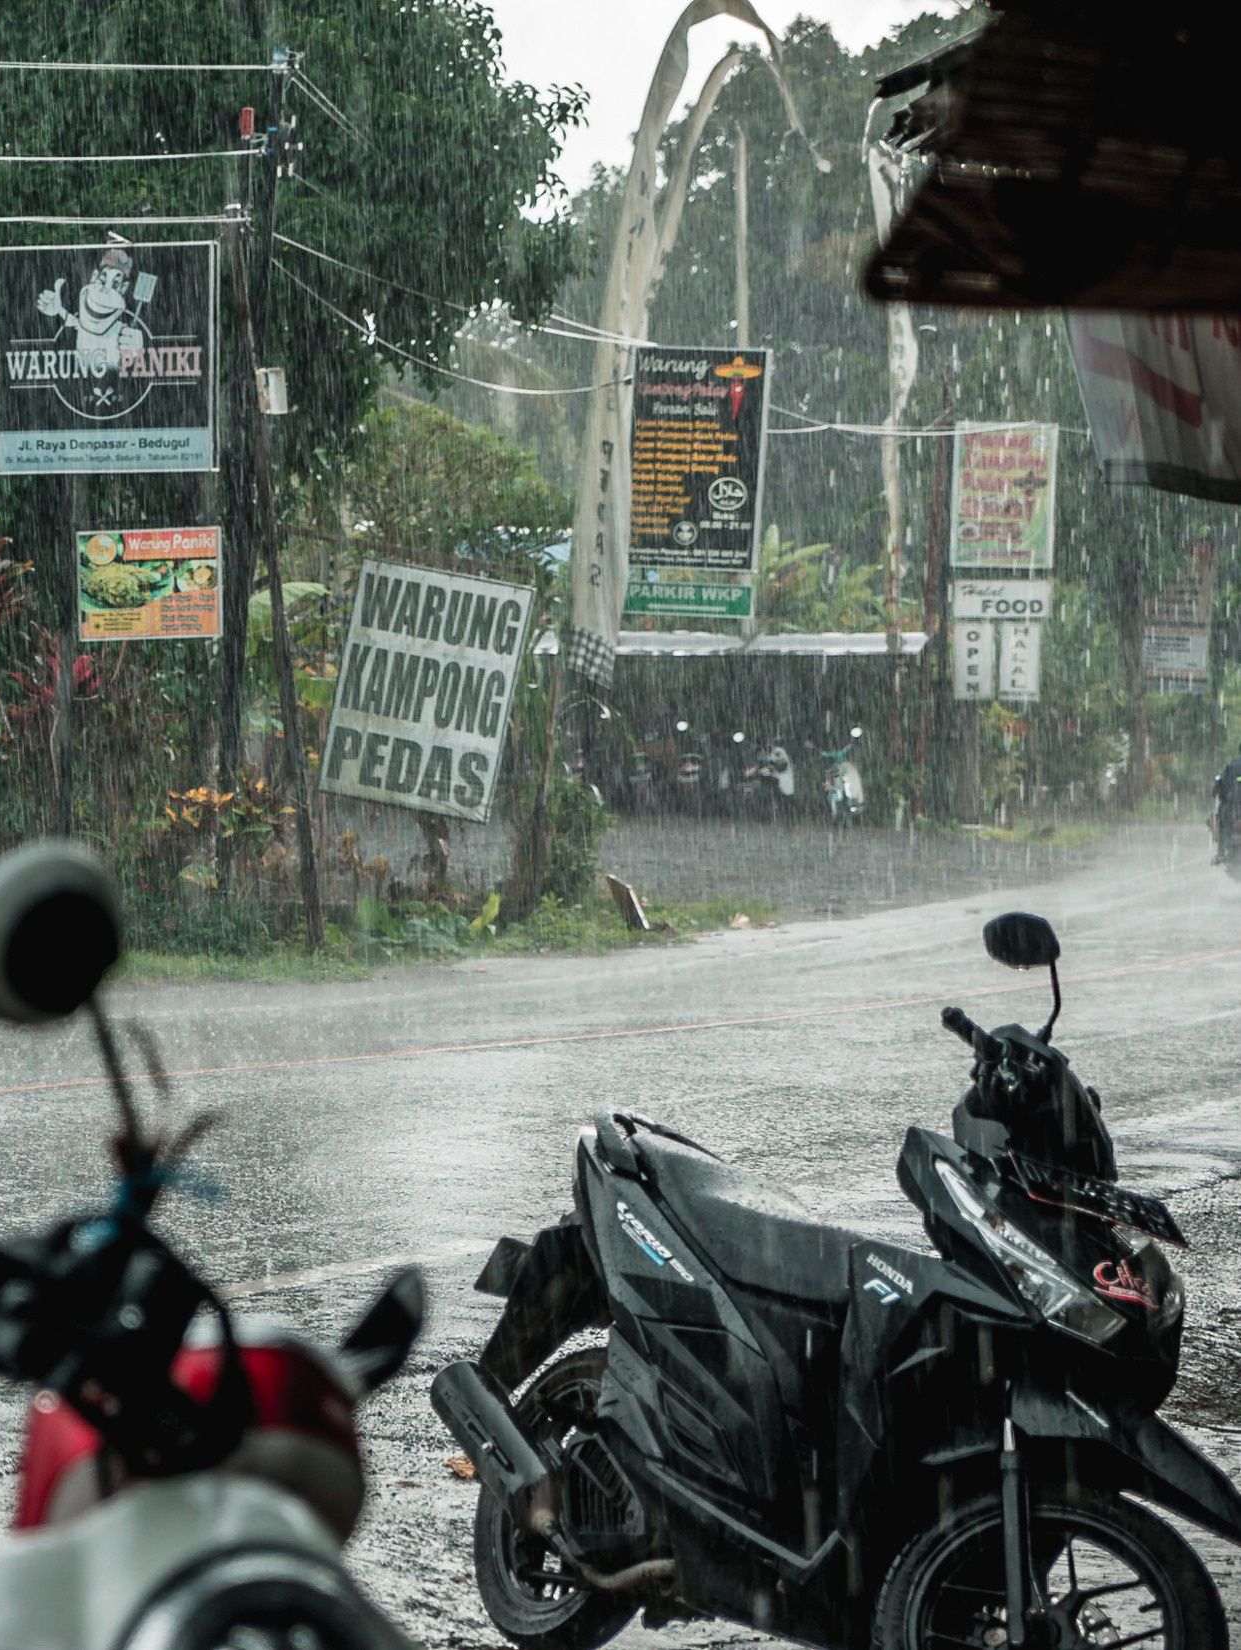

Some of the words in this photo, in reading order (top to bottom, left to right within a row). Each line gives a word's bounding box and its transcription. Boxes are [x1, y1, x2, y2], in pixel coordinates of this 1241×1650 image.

[6, 348, 108, 380] WARUNG
[119, 346, 202, 378] PANIKI
[637, 352, 711, 381] Warung
[36, 439, 66, 454] Raya
[70, 438, 128, 452] Denpasar
[138, 436, 190, 451] Bedugul
[128, 537, 171, 553] Warung
[172, 532, 216, 550] Paniki
[629, 583, 696, 600] PARKIR
[701, 586, 744, 601] WKP
[981, 599, 1044, 614] FOOD
[360, 572, 521, 656] WARUNG
[965, 630, 980, 693] OPEN
[1010, 626, 1029, 689] HALAL
[340, 642, 507, 739] KAMPONG
[326, 725, 490, 809] PEDAS
[866, 1252, 914, 1295] HONDA
